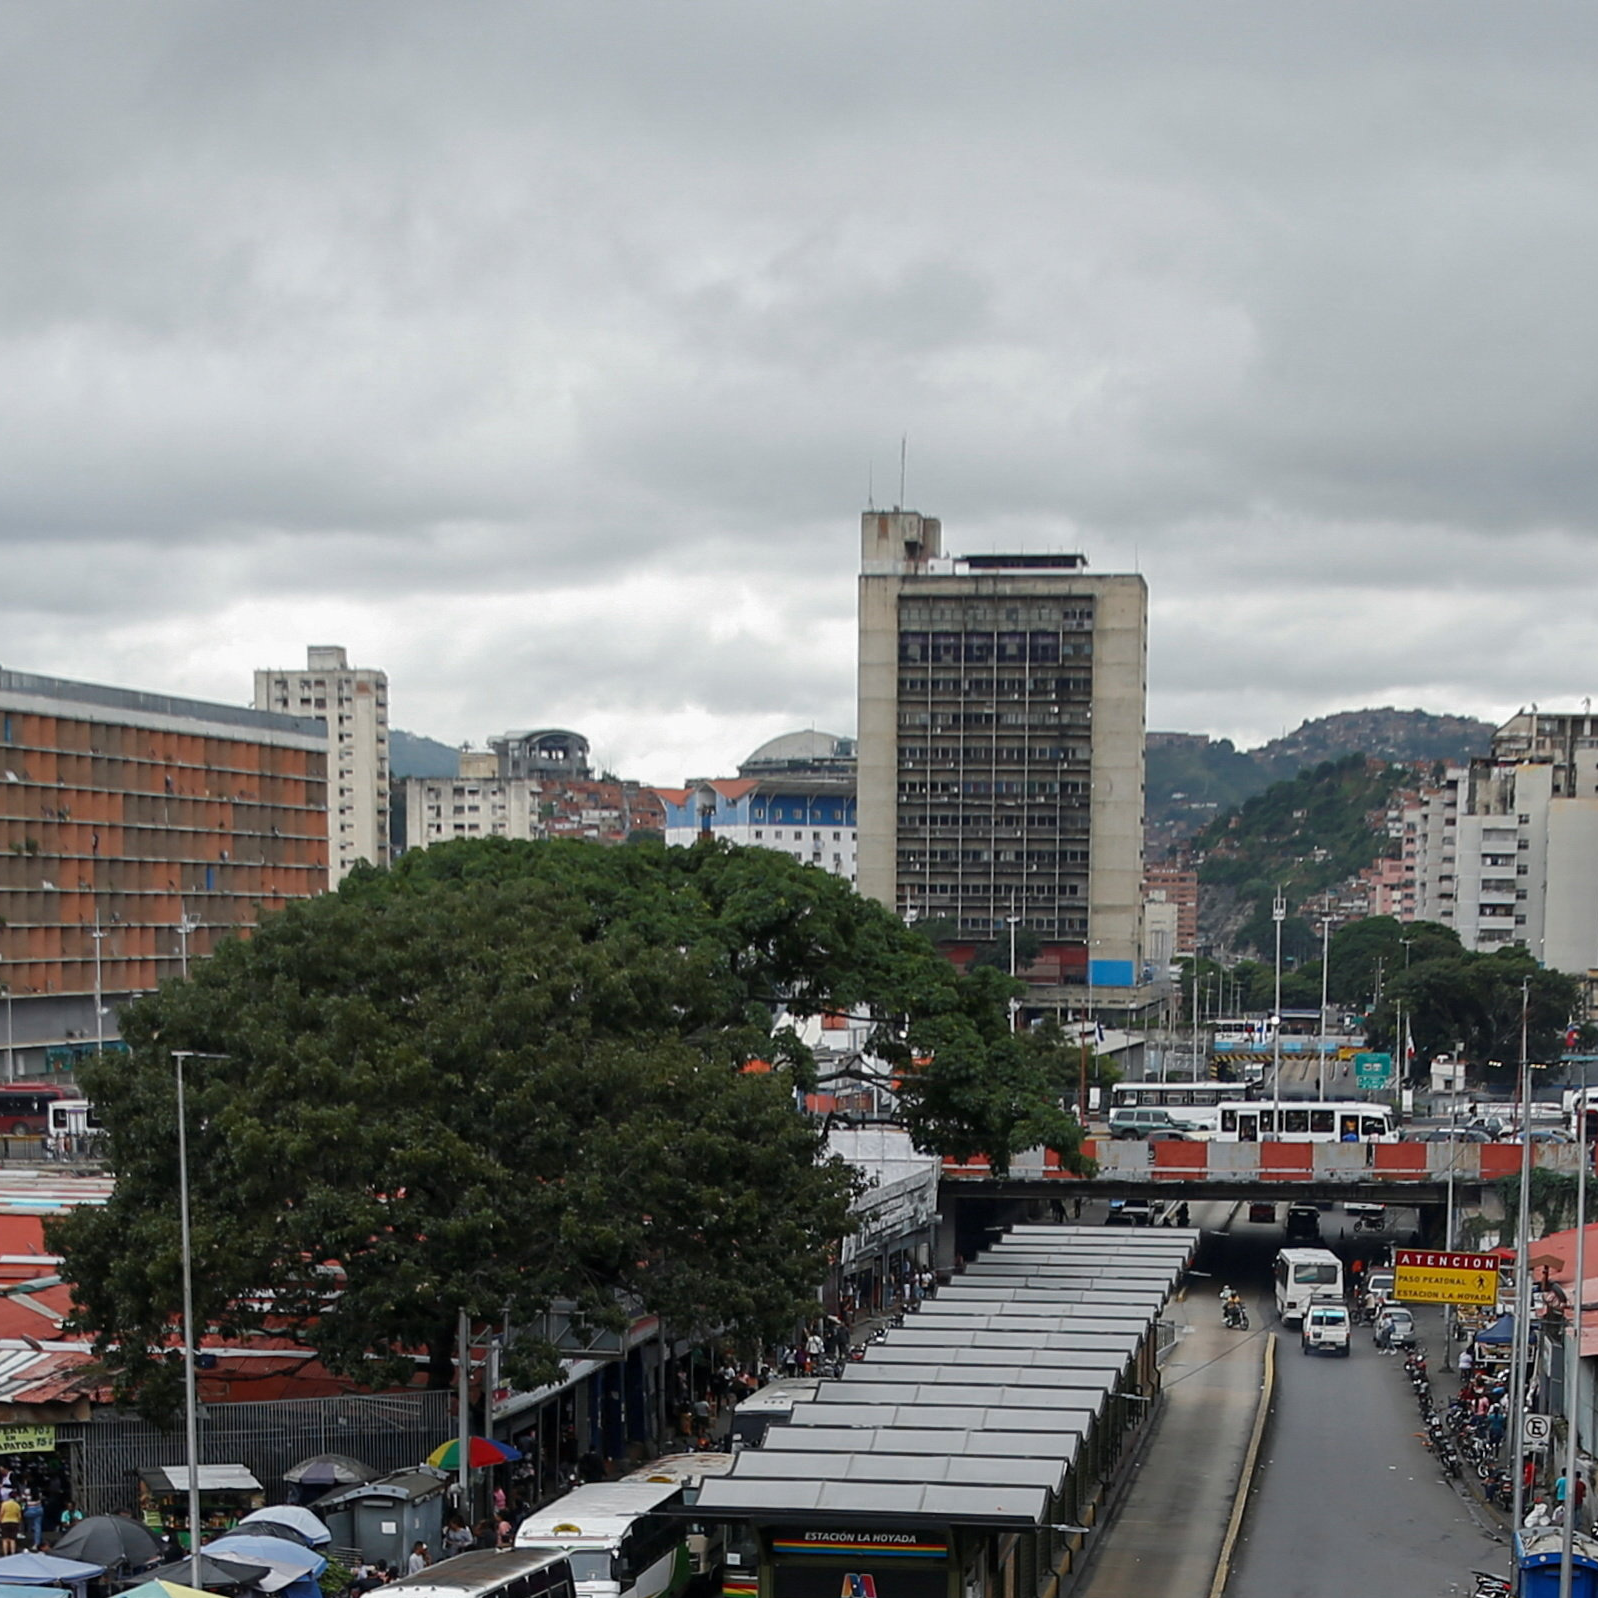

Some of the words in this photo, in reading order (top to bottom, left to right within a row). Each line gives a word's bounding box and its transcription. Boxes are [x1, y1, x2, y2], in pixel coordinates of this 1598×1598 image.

[1401, 1254, 1494, 1269] ATENCION
[1398, 1275, 1420, 1283] PASO
[1422, 1276, 1467, 1286] PEATONAL
[1397, 1290, 1439, 1298] ESTACION
[1442, 1291, 1453, 1299] LA
[1457, 1292, 1492, 1301] HOYADA
[805, 1531, 854, 1542] ESTACIÓN
[857, 1533, 871, 1543] LA
[872, 1534, 917, 1544] HOYADA
